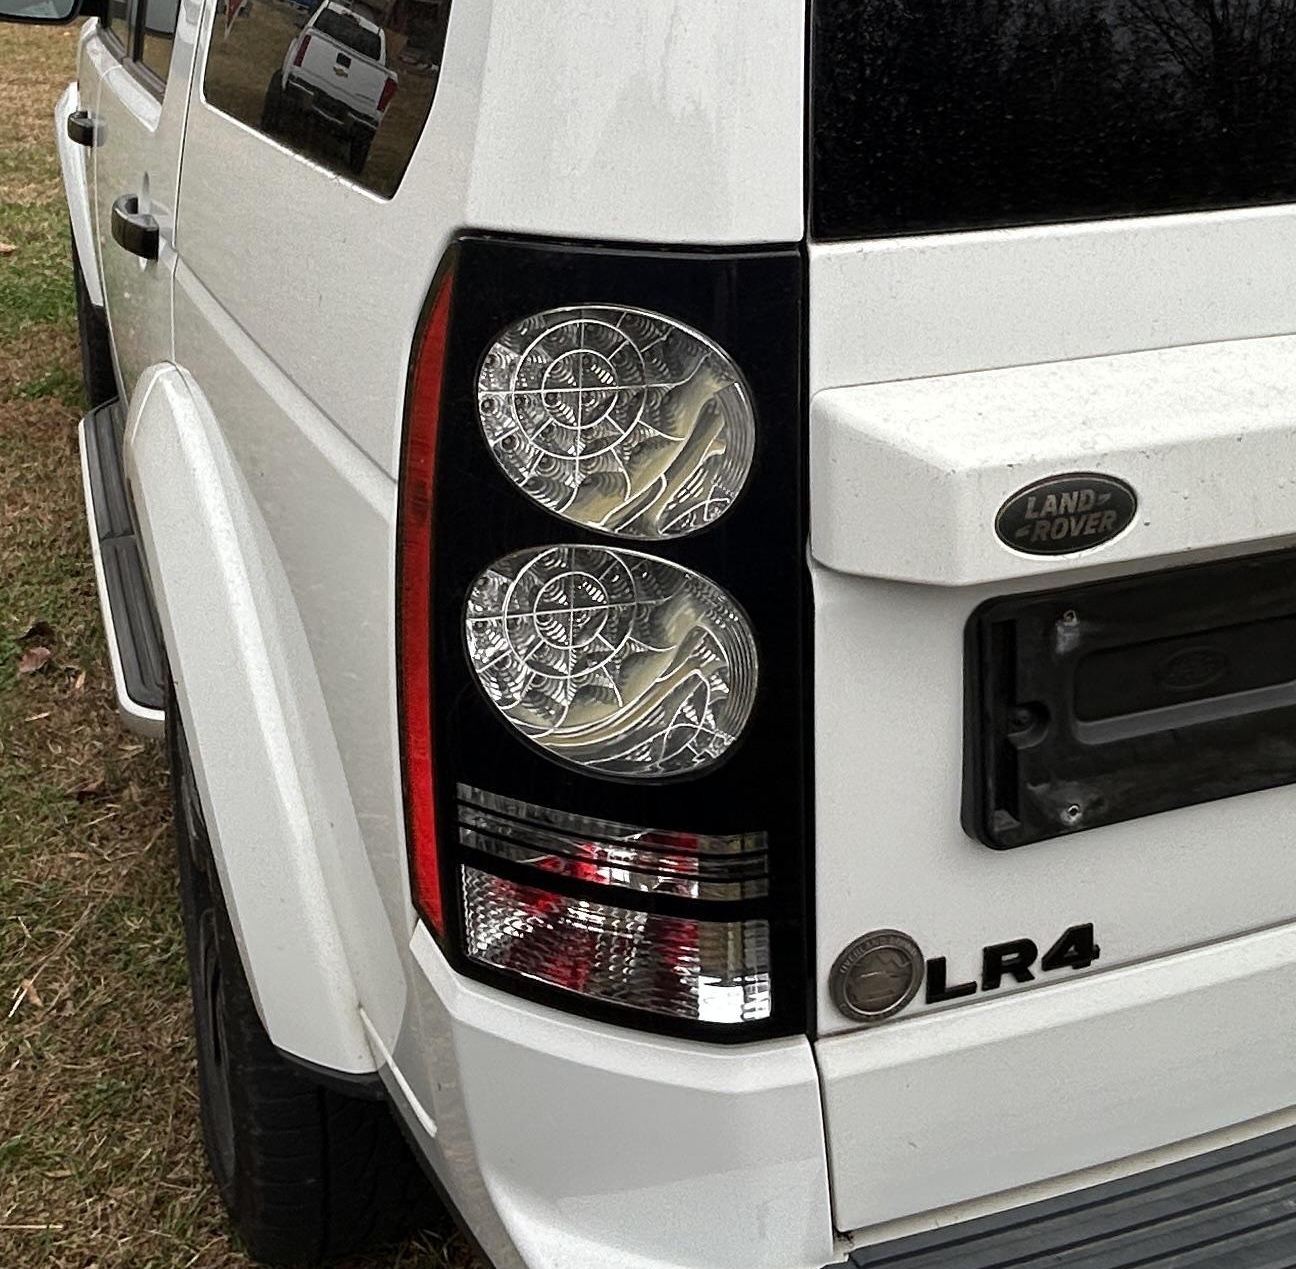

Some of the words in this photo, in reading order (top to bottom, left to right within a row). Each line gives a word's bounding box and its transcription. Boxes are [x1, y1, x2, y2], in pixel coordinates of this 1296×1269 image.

[1024, 488, 1096, 520] LAND
[1030, 509, 1118, 542] ROVER
[925, 922, 1100, 1005] LR4
